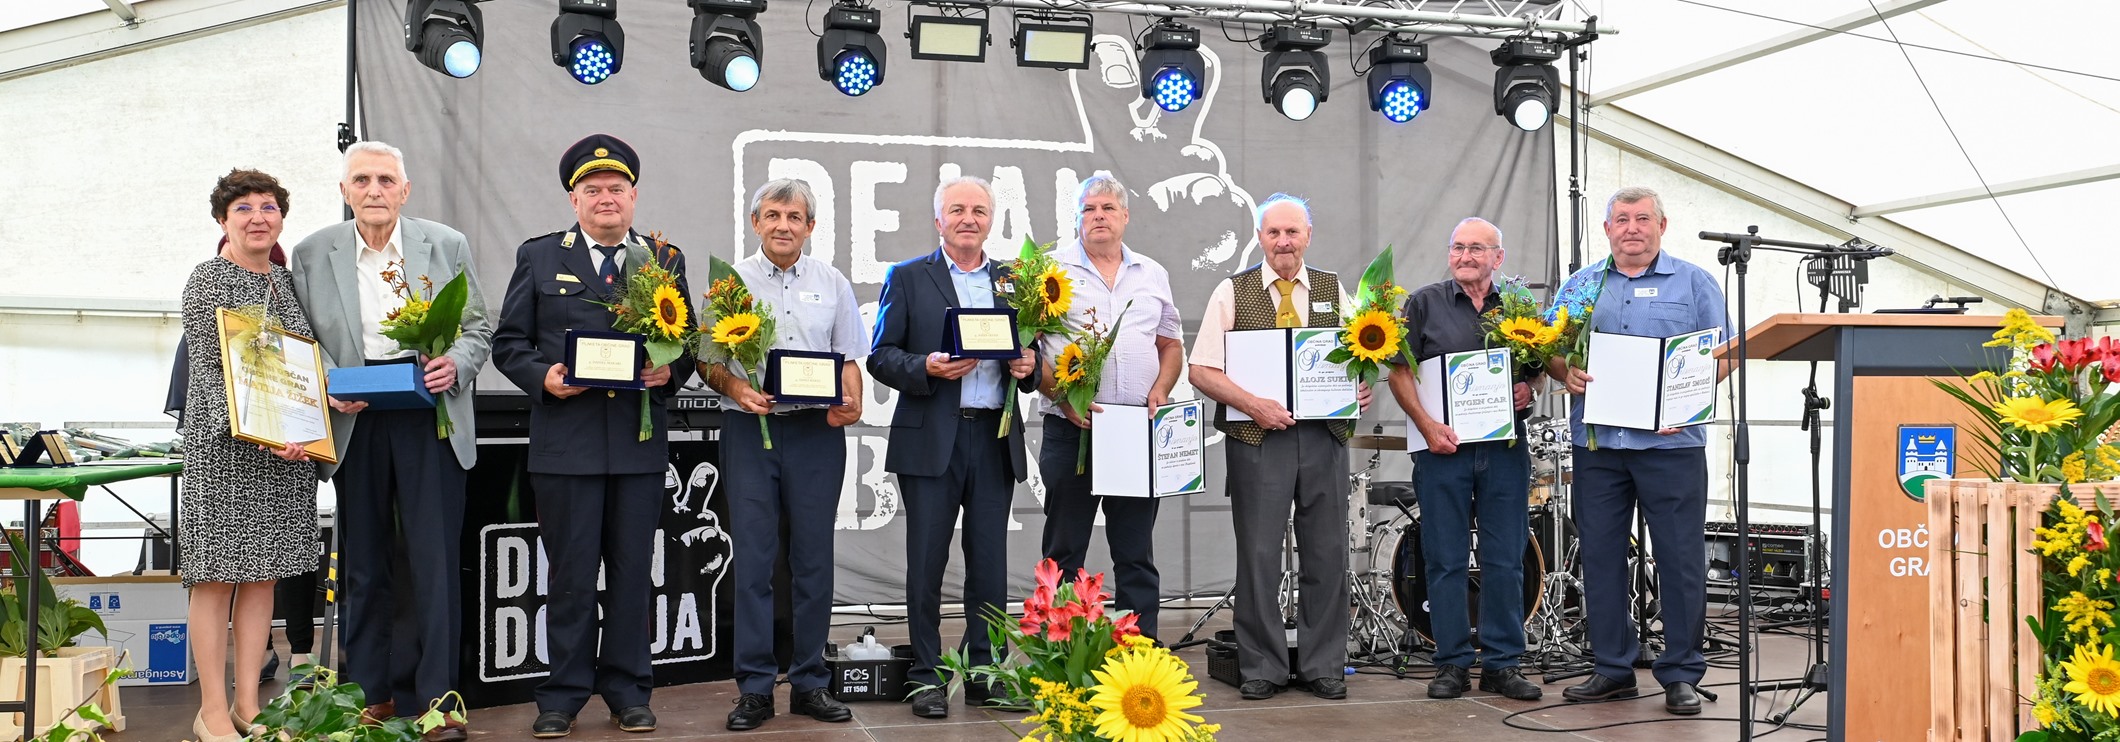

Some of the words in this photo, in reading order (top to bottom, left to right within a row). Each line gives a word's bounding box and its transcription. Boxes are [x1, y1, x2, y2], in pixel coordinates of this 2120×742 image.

[768, 157, 1114, 285] DEAN
[1666, 381, 1691, 392] STANISLAV
[1454, 398, 1486, 408] EVGEN
[1487, 396, 1507, 405] CAR
[1158, 451, 1179, 461] ŠTEFAN
[1179, 448, 1199, 458] NEMET
[1878, 523, 1929, 549] OBČ
[844, 668, 870, 681] FOS
[853, 685, 868, 693] 1500
